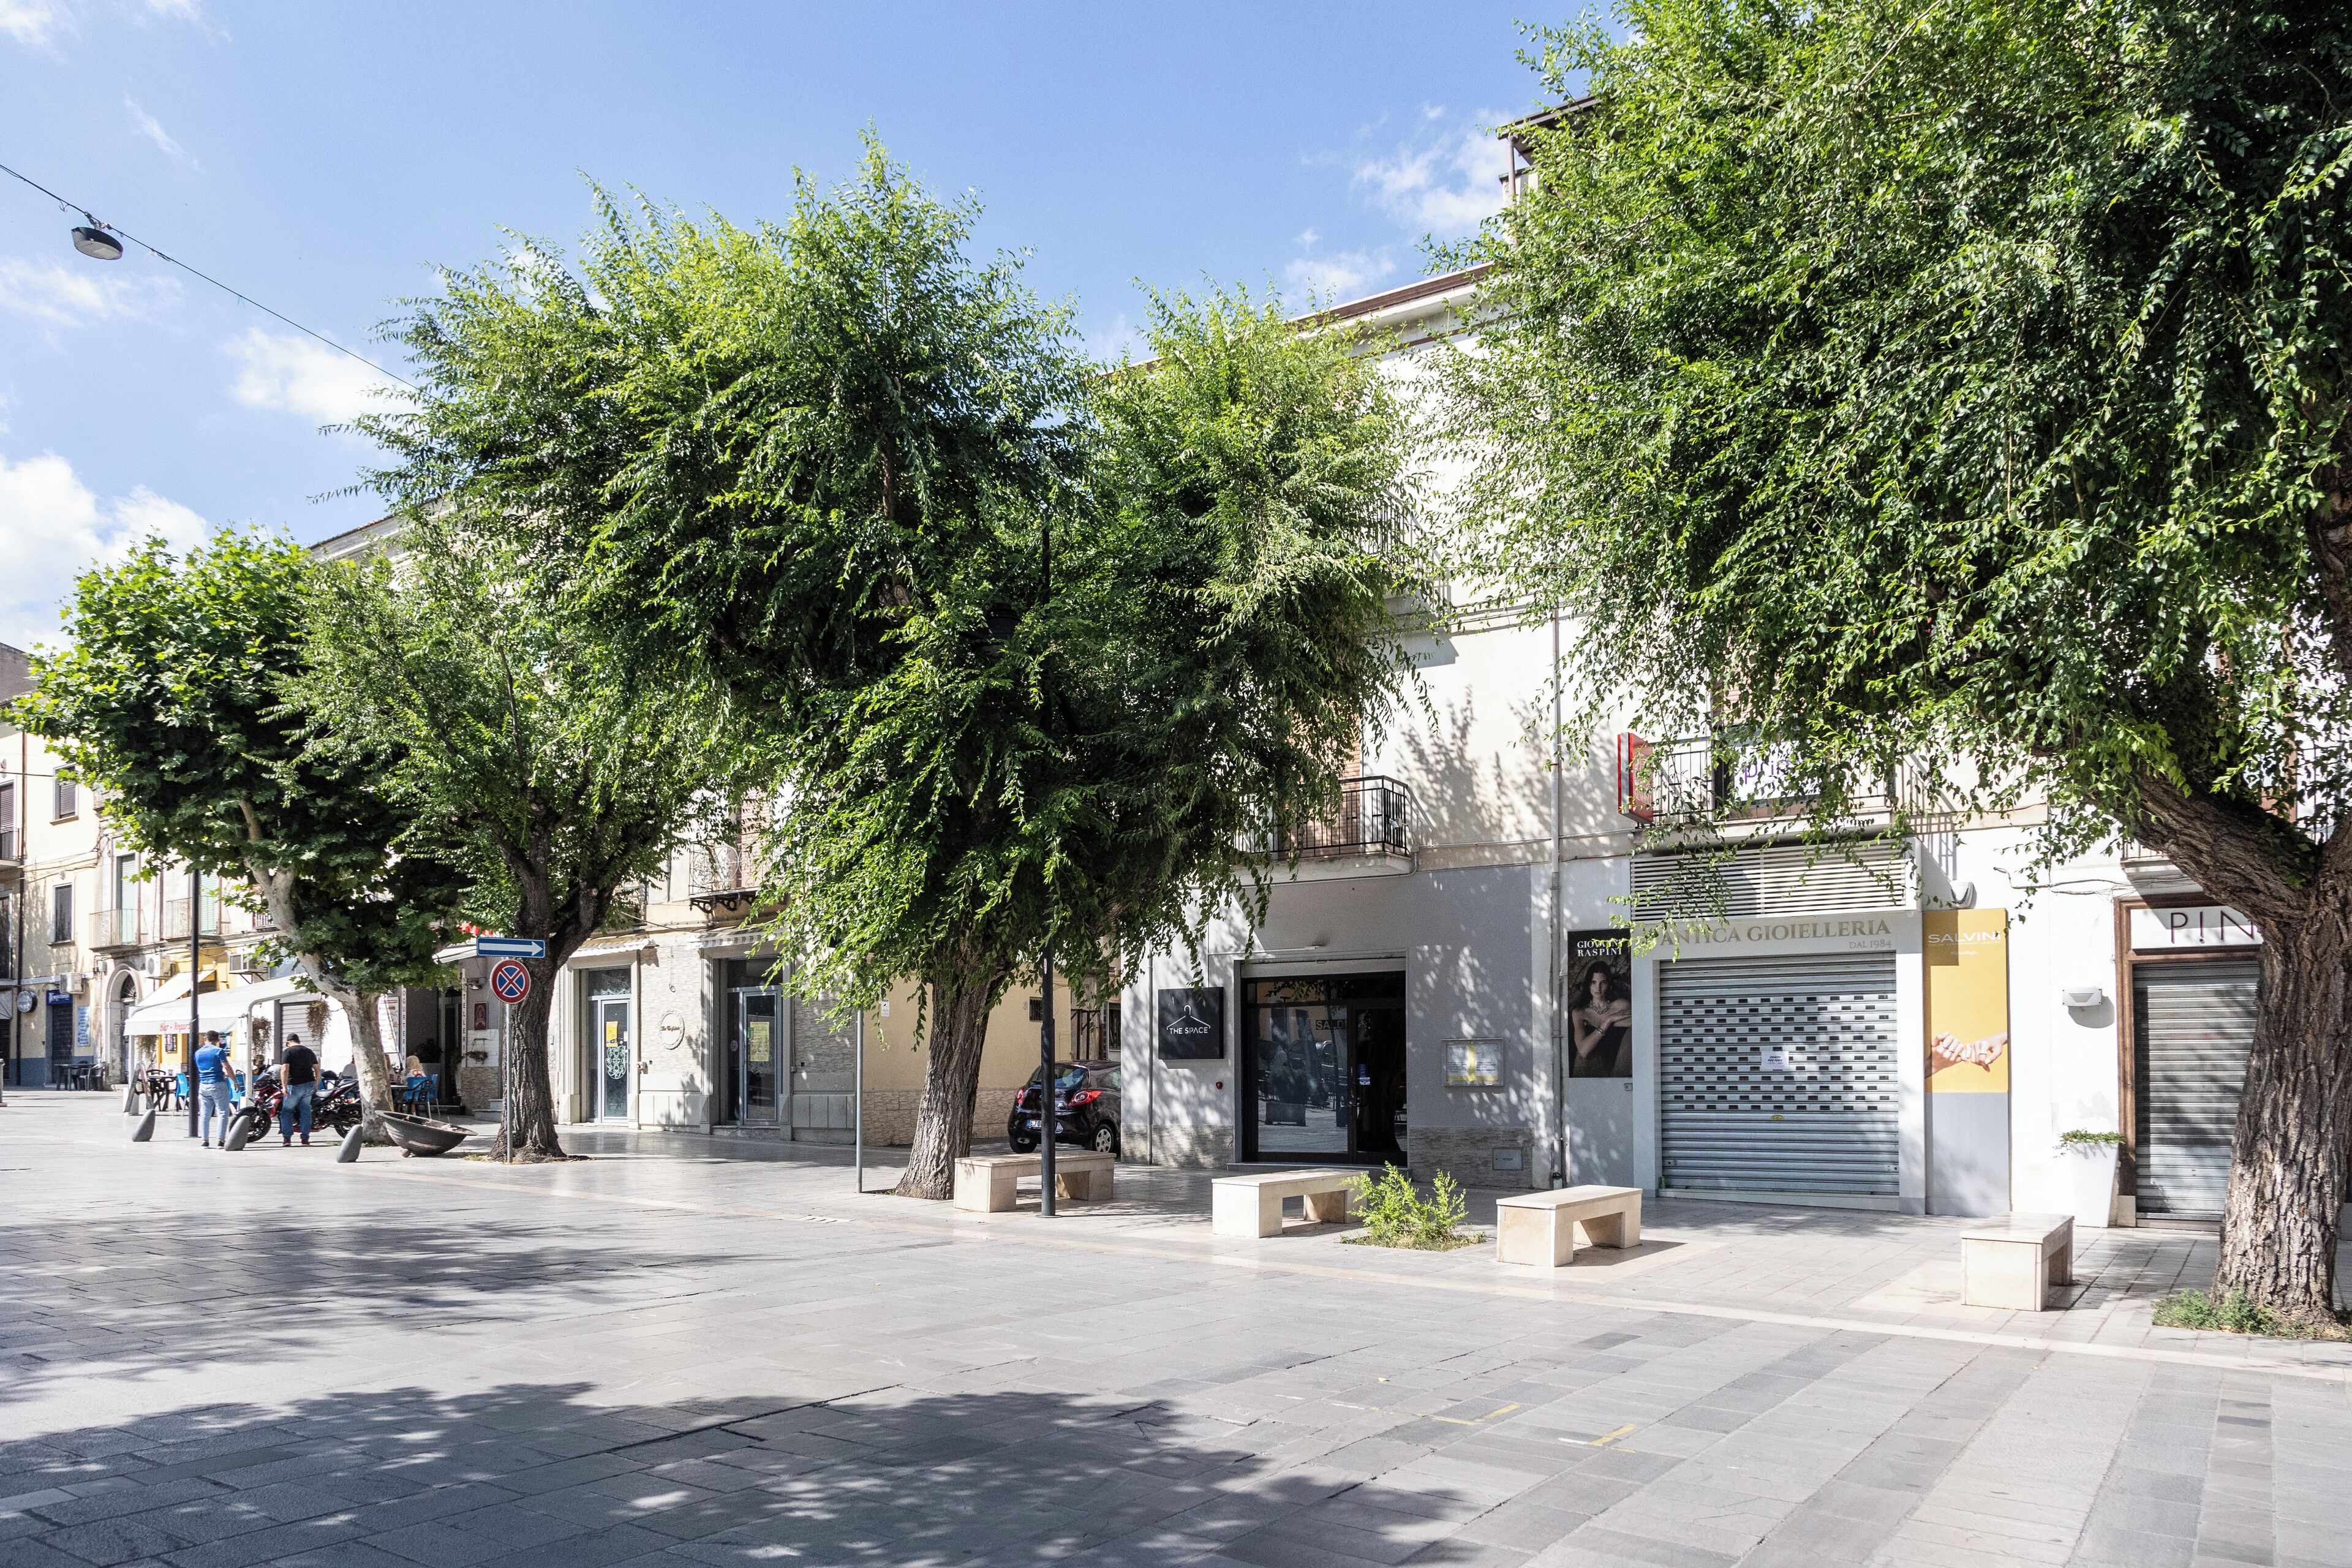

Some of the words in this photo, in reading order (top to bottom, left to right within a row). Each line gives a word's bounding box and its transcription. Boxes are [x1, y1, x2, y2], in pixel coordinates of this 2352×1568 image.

[1659, 927, 1742, 946] ANTICA
[1747, 919, 1891, 942] GIOIELLERIA
[1928, 931, 2002, 943] SALVINI
[1869, 939, 1892, 949] 1984
[1578, 948, 1622, 957] RASPINI
